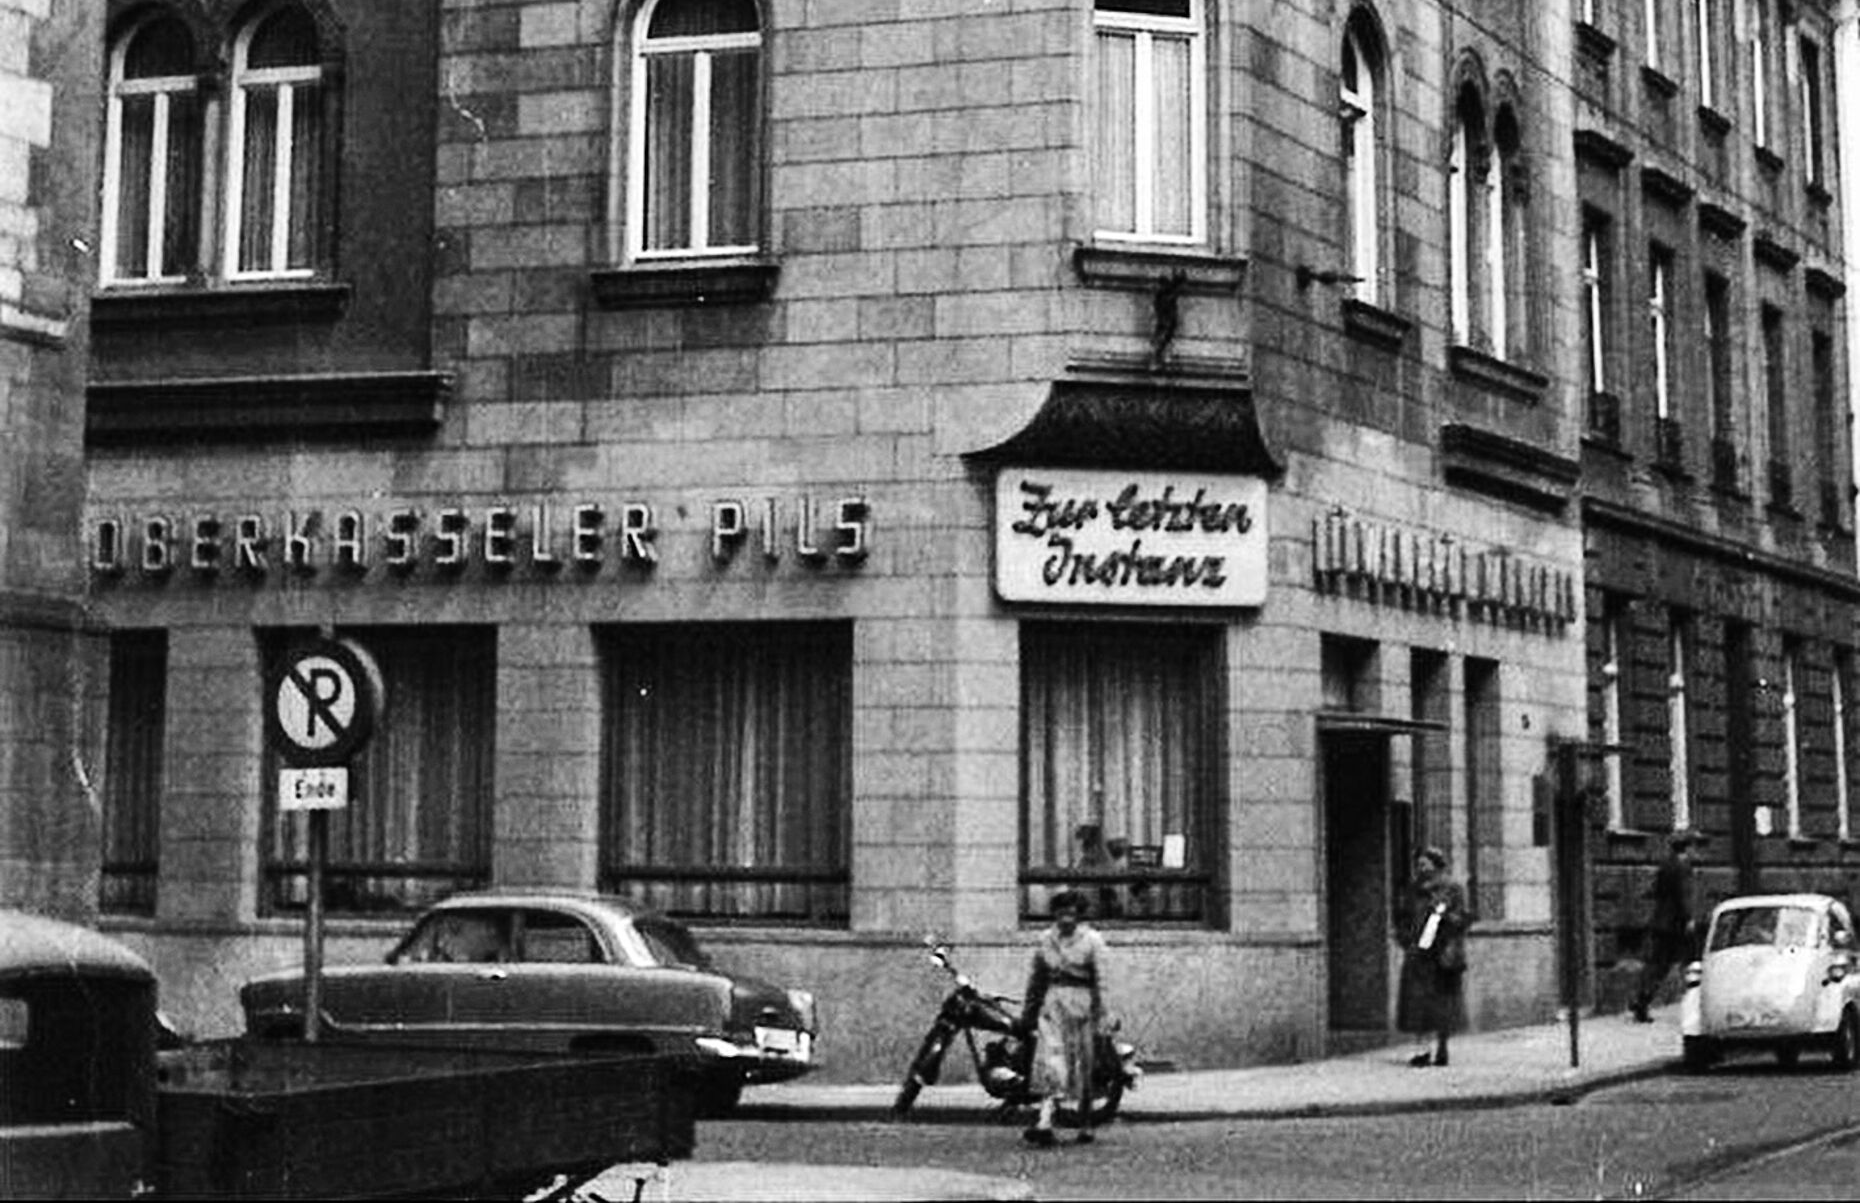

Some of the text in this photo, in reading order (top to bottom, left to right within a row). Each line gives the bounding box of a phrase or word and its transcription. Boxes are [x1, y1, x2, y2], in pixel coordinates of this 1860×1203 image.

[91, 498, 870, 571] OBERKASSELER PILS
[1011, 480, 1099, 538] Zur
[1042, 533, 1227, 588] Instanz
[294, 778, 336, 799] Ende
